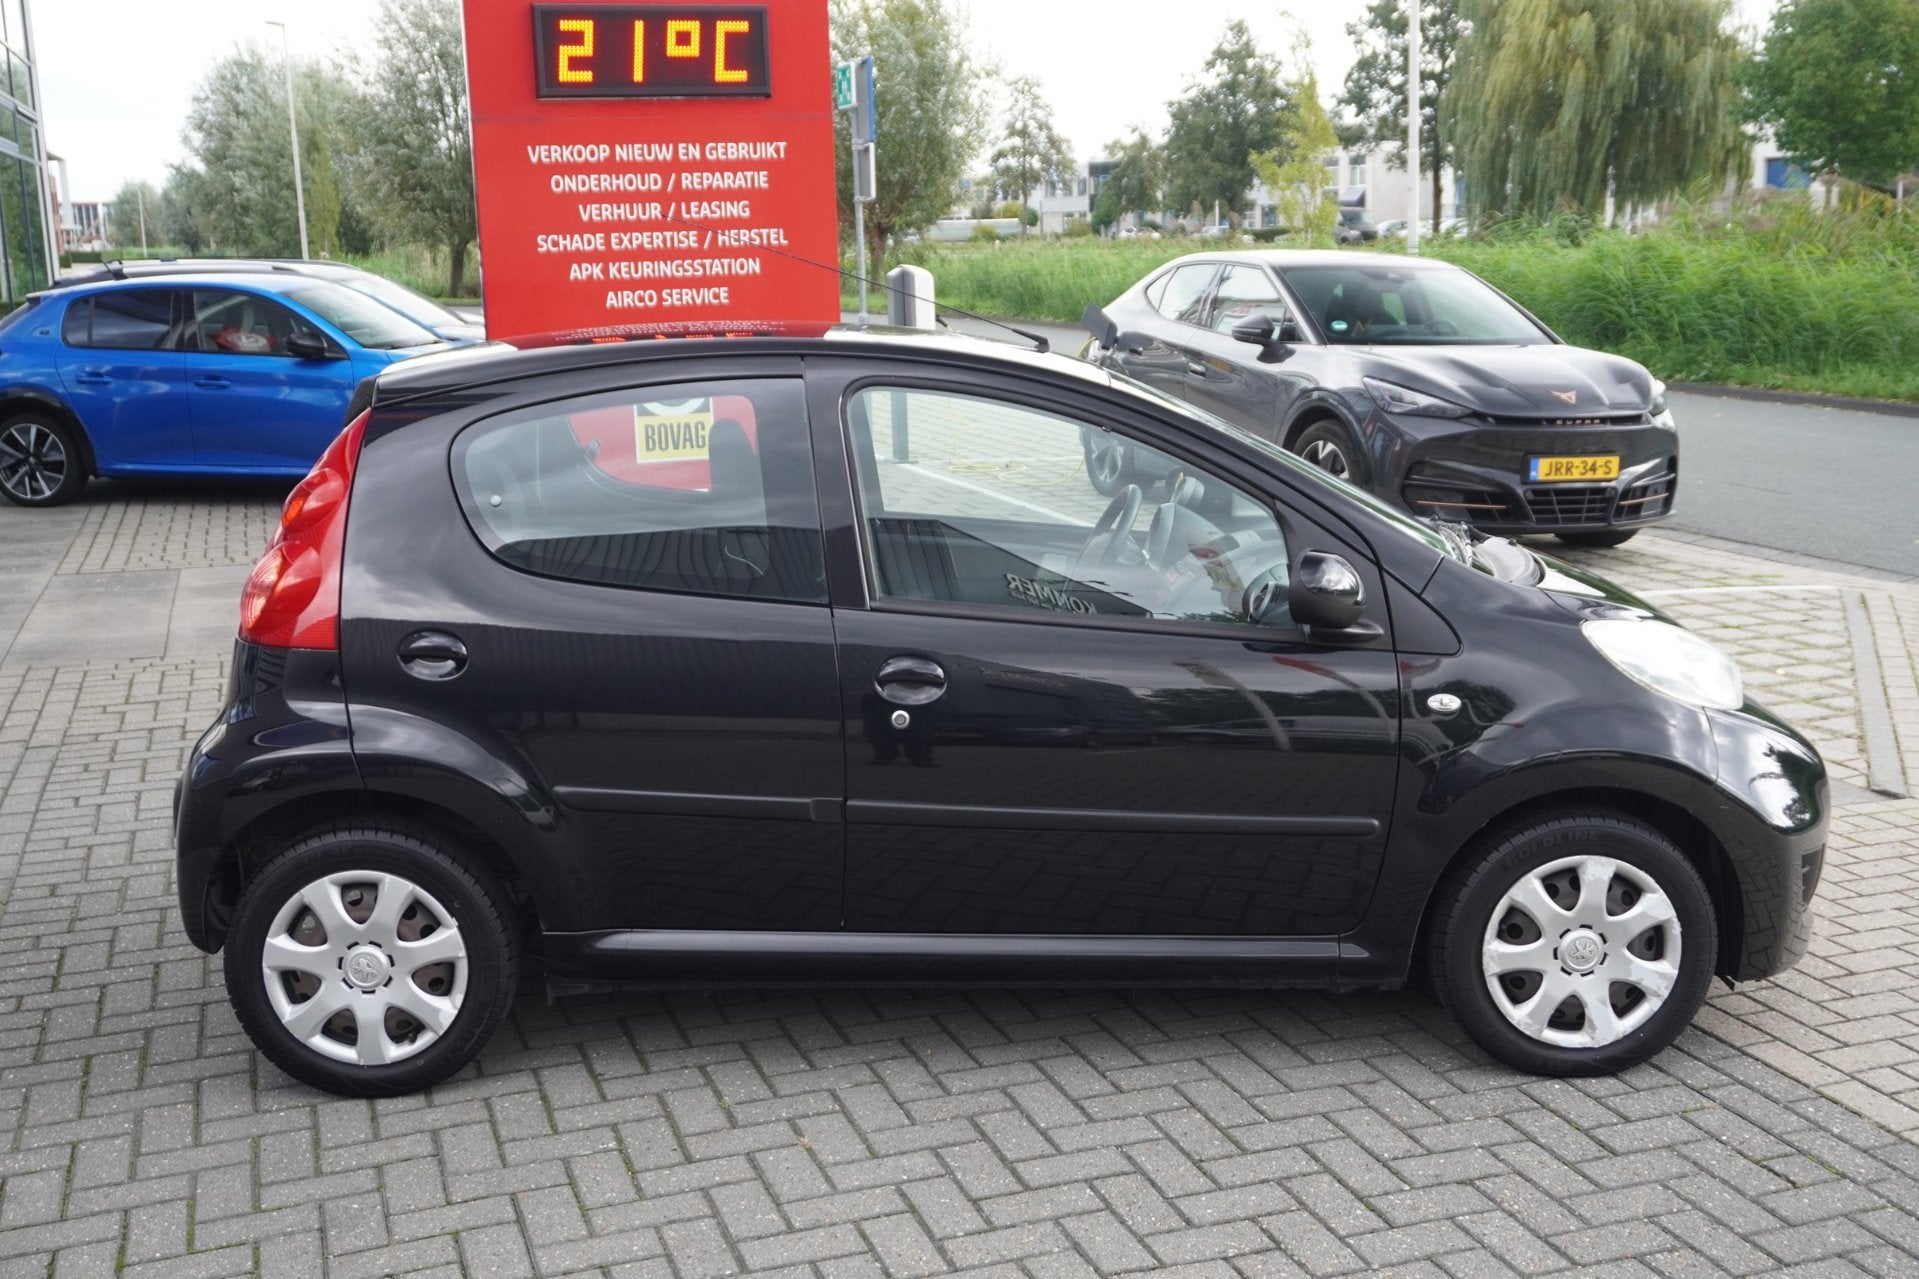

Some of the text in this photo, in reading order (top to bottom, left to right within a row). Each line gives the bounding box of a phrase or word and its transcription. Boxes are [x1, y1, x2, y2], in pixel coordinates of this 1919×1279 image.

[526, 141, 787, 163] VERKOOP NIEUW EN GEBRUIKT
[550, 171, 769, 193] ONDERHOUD / REPARATIE
[578, 200, 751, 221] VERHUUR / LEASING
[536, 228, 789, 252] SCHADE EXPERTISE / HERSTEL
[569, 257, 761, 281] APK KEURINGSSTATION
[605, 287, 730, 308] AIRCO SERVICE
[643, 420, 707, 452] BOVAG
[1544, 459, 1613, 477] JRR-34-S
